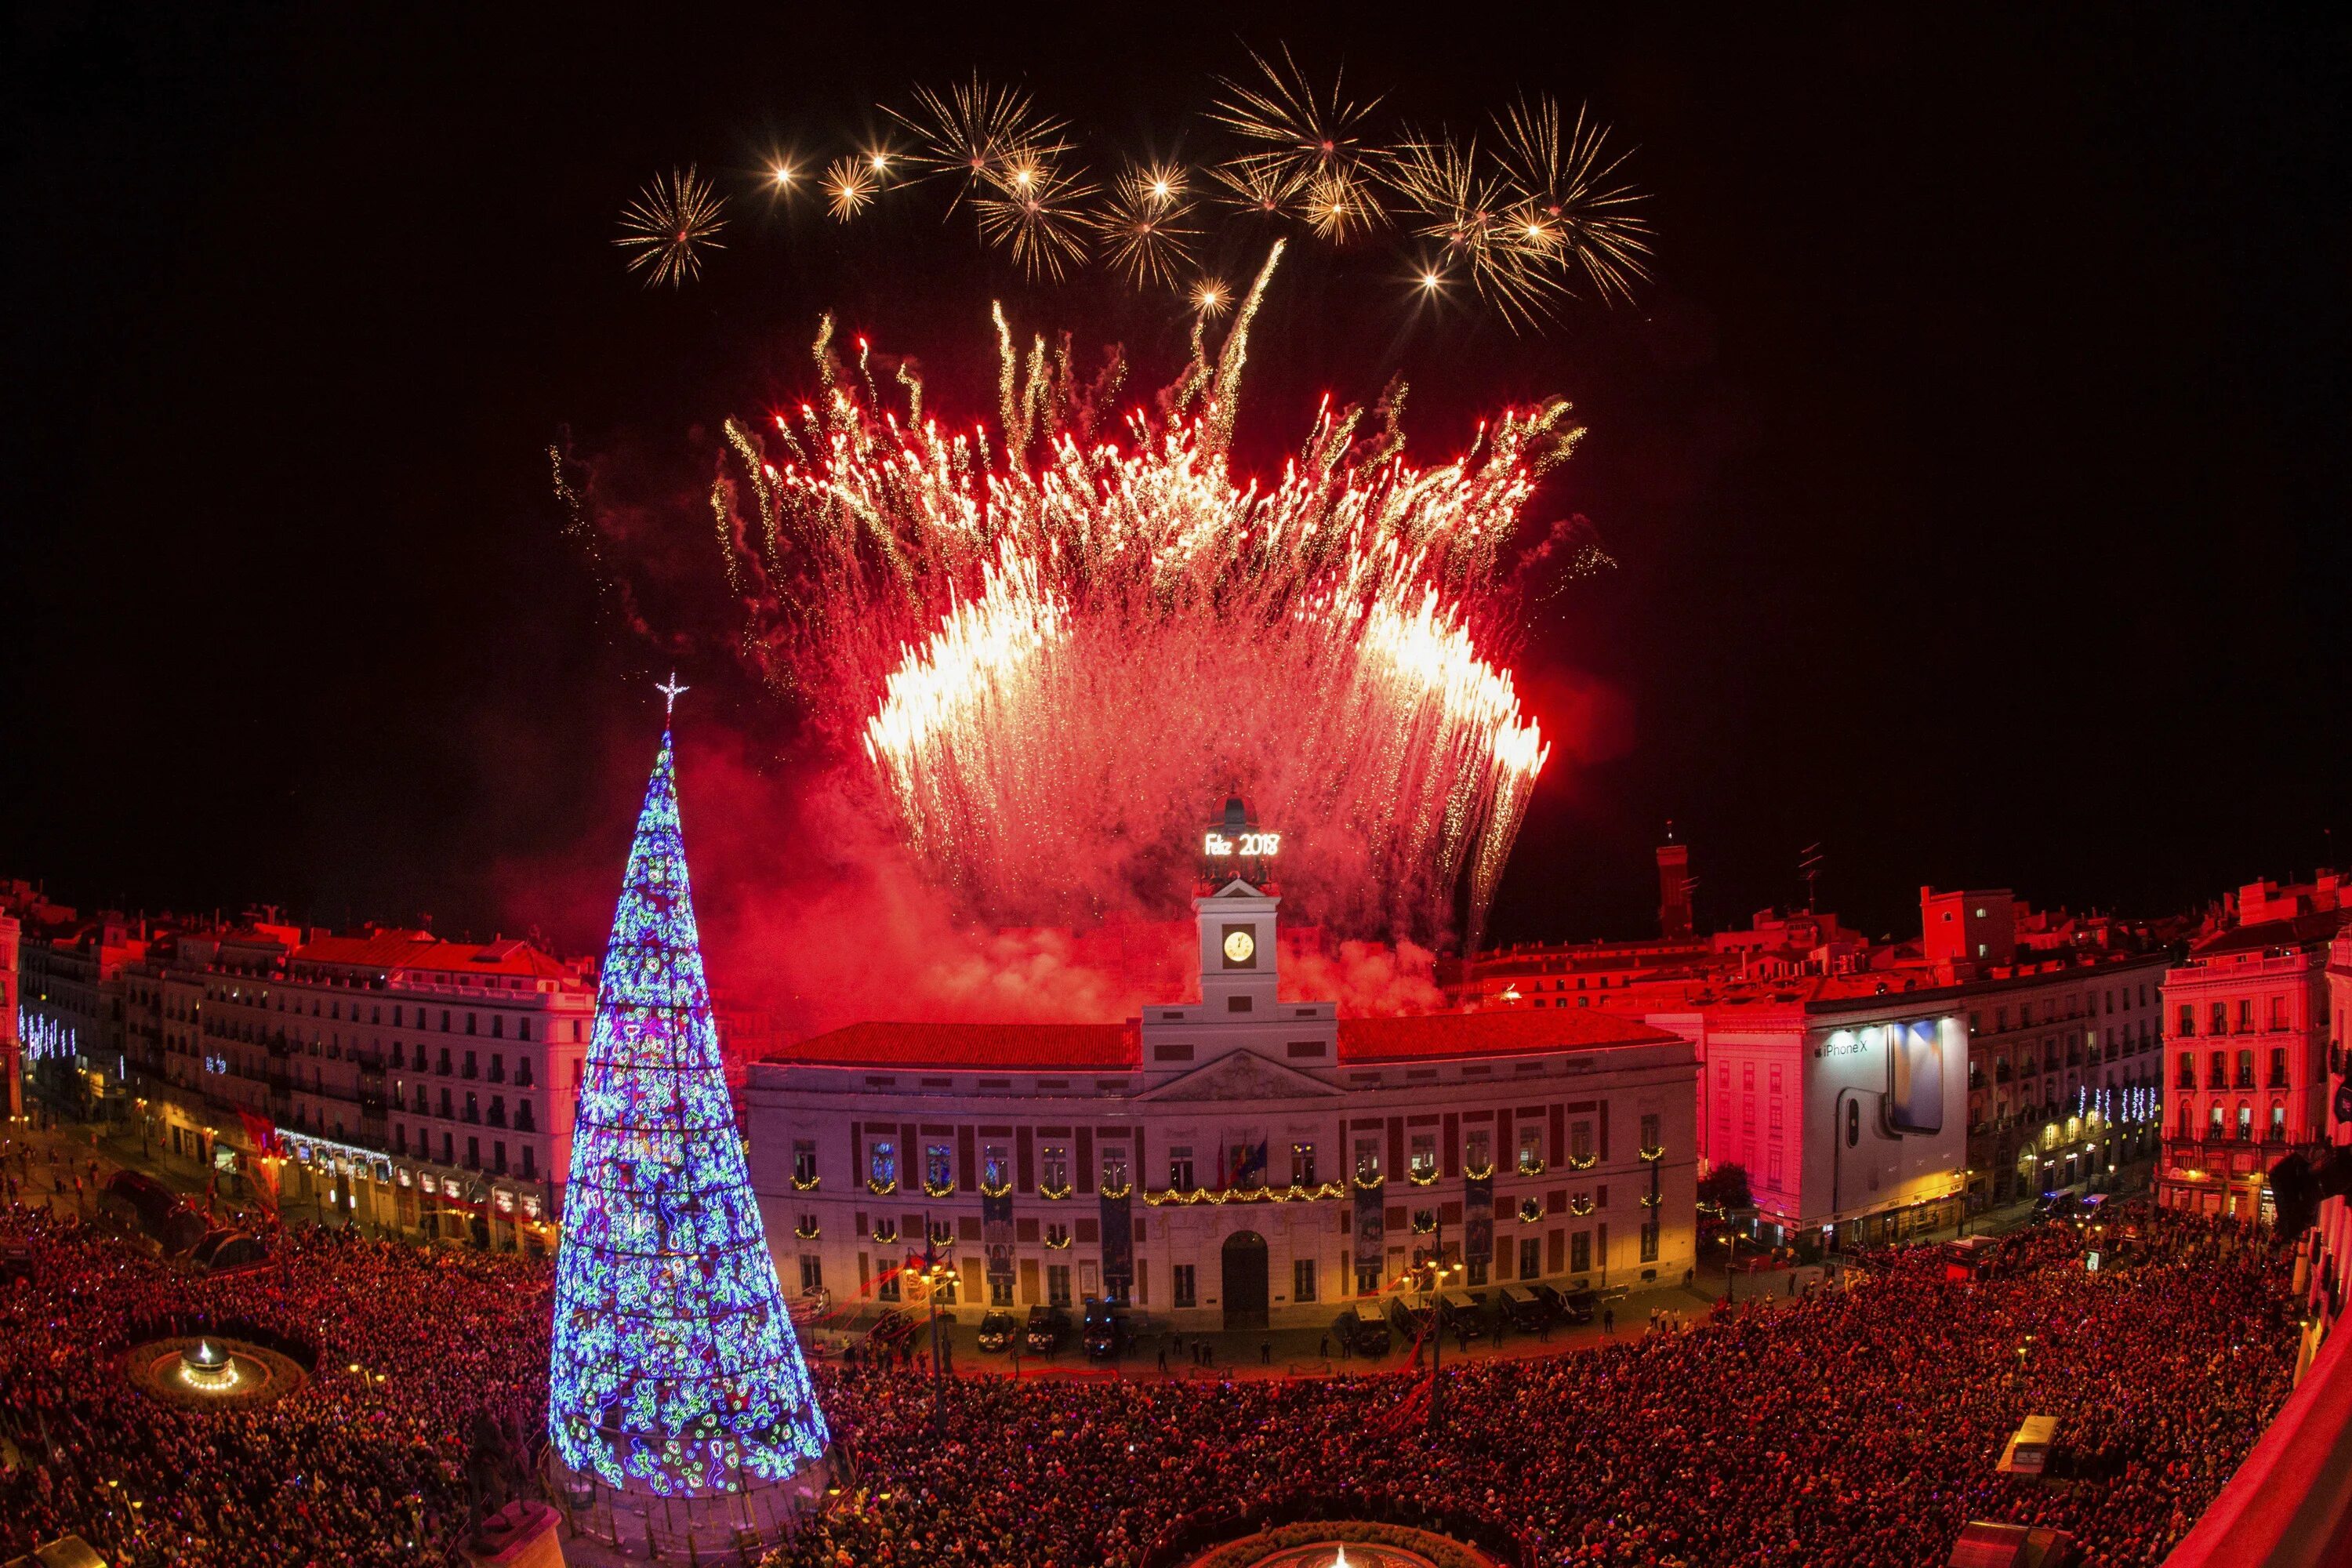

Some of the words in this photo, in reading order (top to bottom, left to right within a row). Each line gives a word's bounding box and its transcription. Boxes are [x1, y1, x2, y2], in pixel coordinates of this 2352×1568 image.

[1239, 833, 1279, 855] 2018
[1824, 1044, 1858, 1057] iPhone
[1860, 1040, 1867, 1052] X
